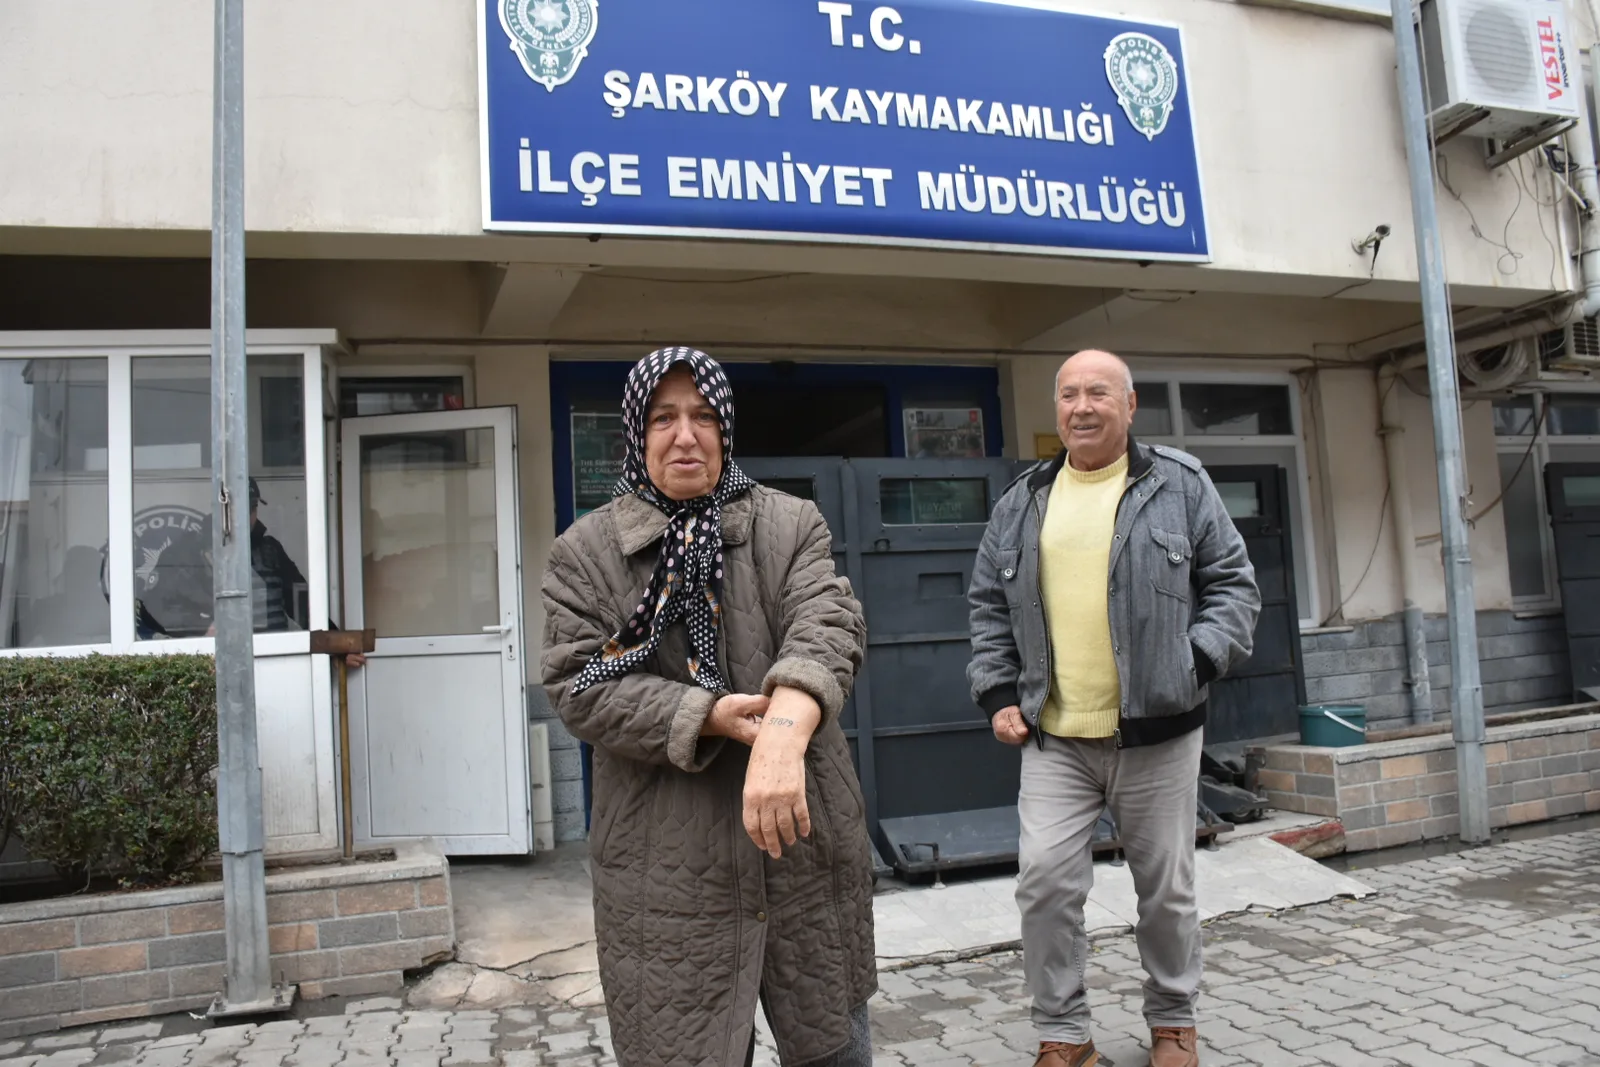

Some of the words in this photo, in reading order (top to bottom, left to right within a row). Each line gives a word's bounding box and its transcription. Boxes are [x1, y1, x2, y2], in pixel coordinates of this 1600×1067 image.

[818, 1, 921, 55] T.C.
[1537, 16, 1562, 100] VESTEL
[602, 69, 788, 119] ŞARKÖY
[809, 84, 1114, 147] KAYMAKAMLIĞI
[518, 137, 642, 207] İLÇE
[666, 151, 893, 208] EMNİYET
[917, 163, 1187, 229] MÜDÜRLÜĞÜ
